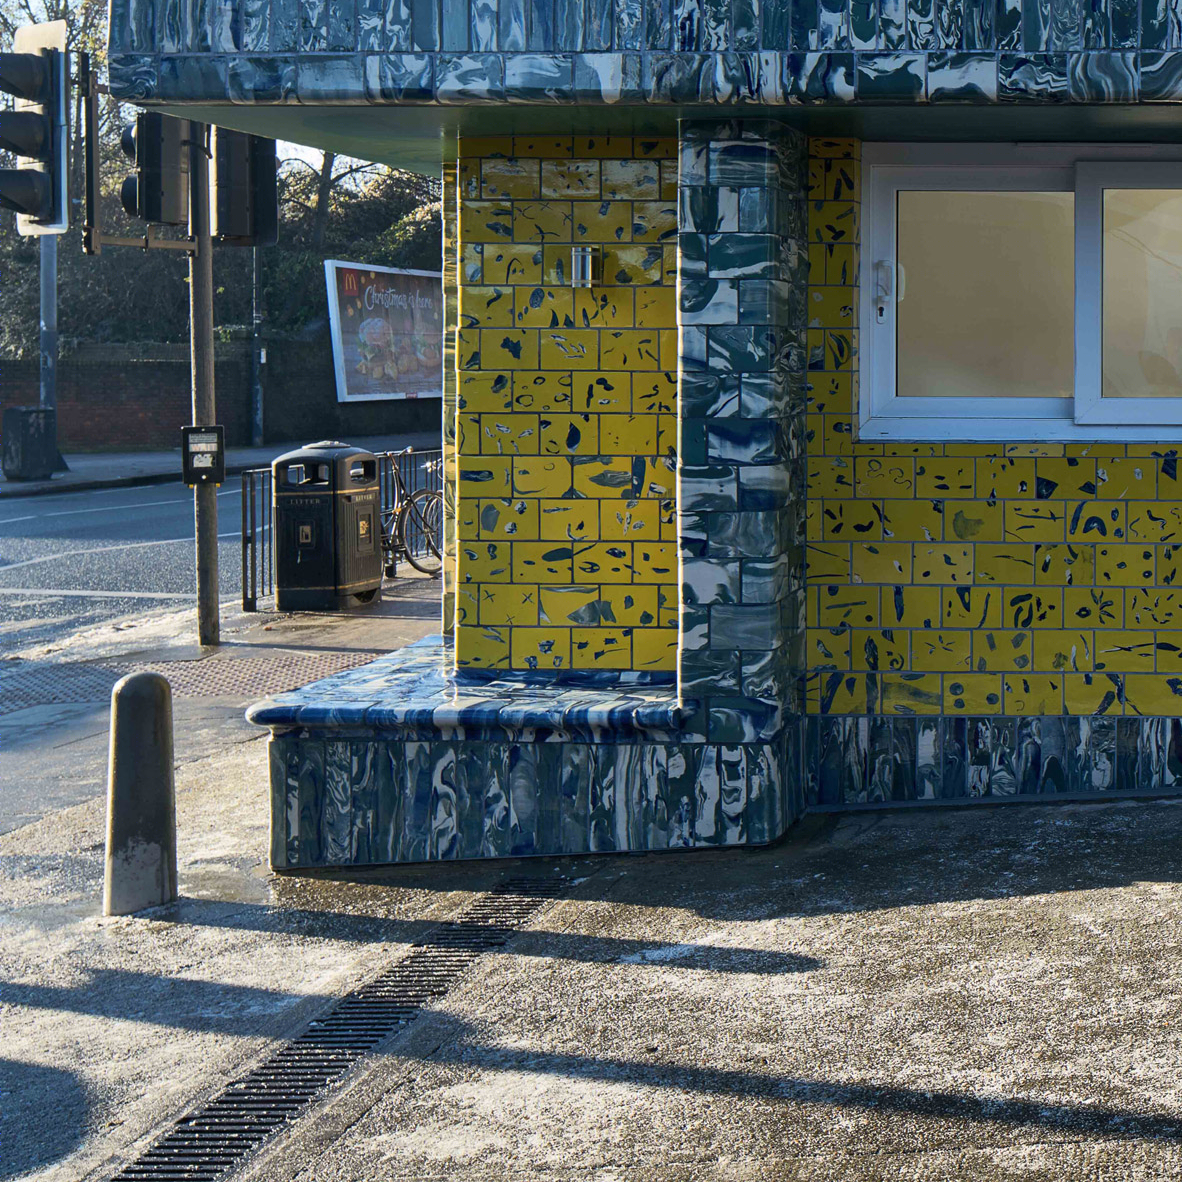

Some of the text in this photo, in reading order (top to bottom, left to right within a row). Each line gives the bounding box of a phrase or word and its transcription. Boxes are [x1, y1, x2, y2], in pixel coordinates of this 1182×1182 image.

[364, 284, 433, 310] Christmas is here
